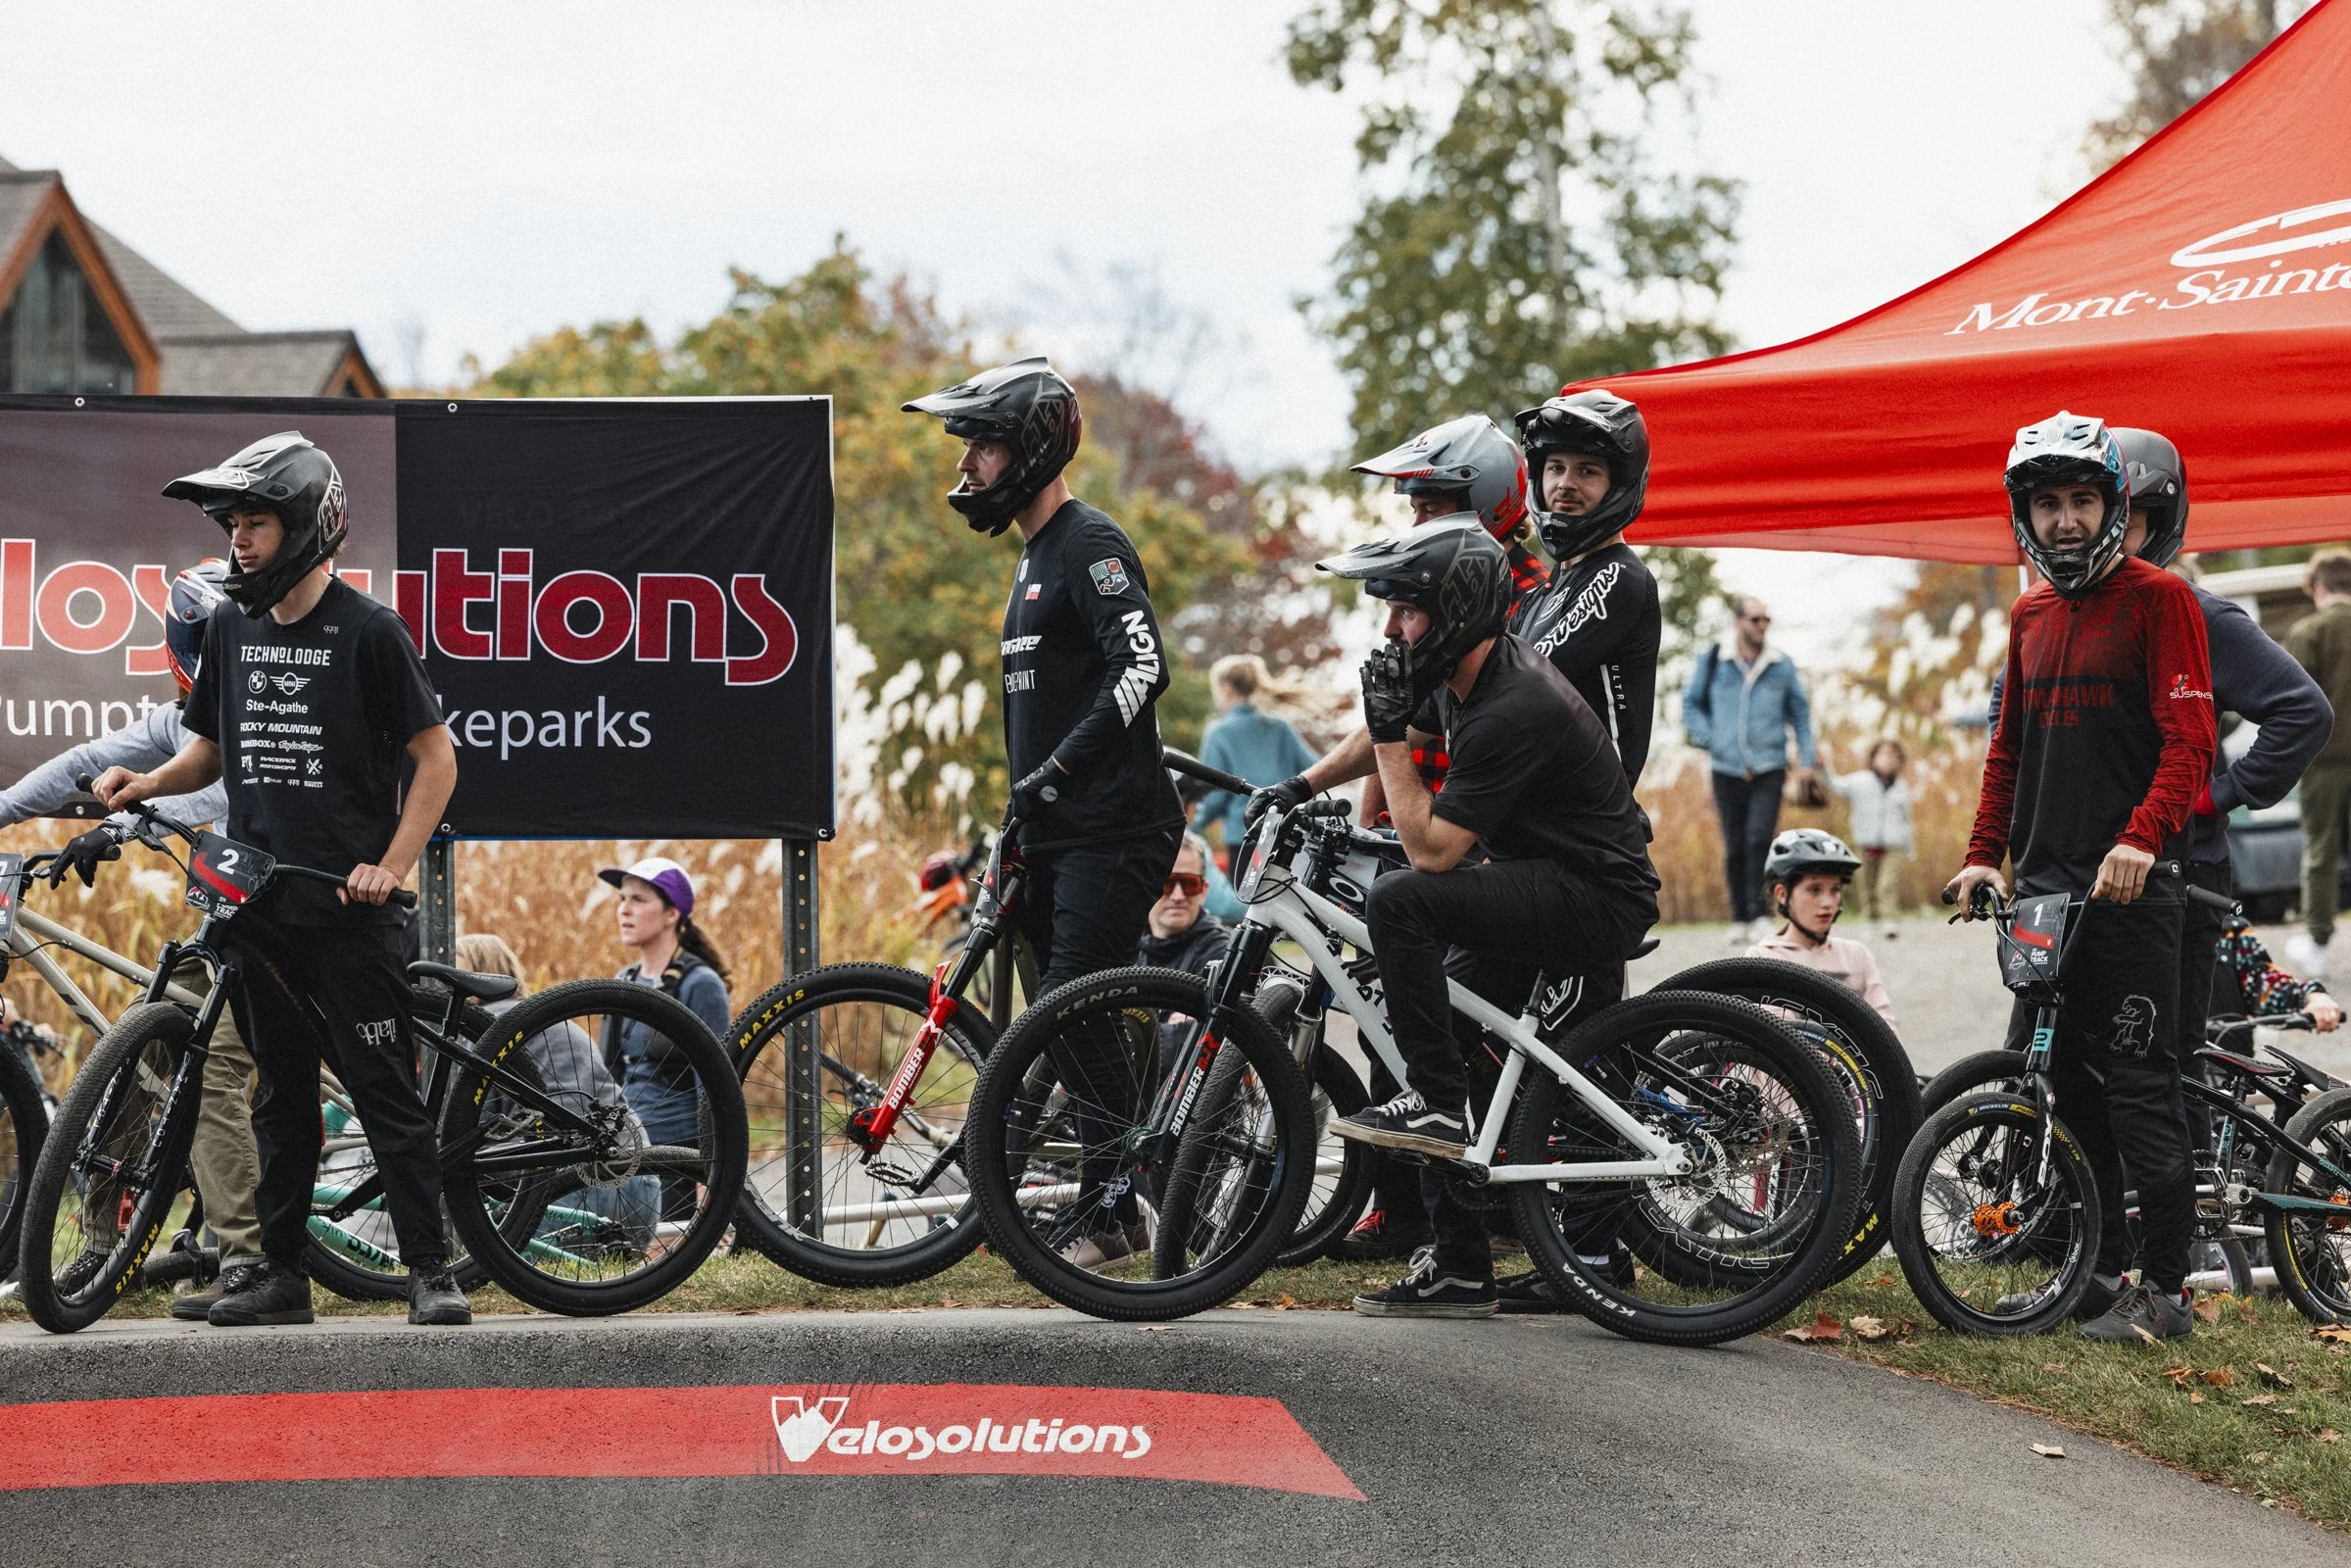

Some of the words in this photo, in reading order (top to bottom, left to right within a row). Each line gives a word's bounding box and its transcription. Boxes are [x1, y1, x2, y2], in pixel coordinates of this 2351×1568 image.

[246, 699, 308, 714] Ste-Agathe
[1611, 664, 1627, 710] ULTRA
[240, 721, 267, 732] RCKY
[268, 723, 322, 736] MOUNTAIN
[436, 695, 652, 760] keparks
[217, 848, 239, 875] 2
[2033, 903, 2044, 927] 1
[739, 988, 806, 1051] MAXXIS
[1056, 986, 1139, 1021] KENDA
[1122, 1007, 1151, 1025] AXXIS
[888, 1047, 925, 1111] BOMBER
[1169, 1065, 1205, 1137] BOMBER
[114, 1223, 159, 1295] MAXXIS
[1563, 1262, 1637, 1317] KENDA
